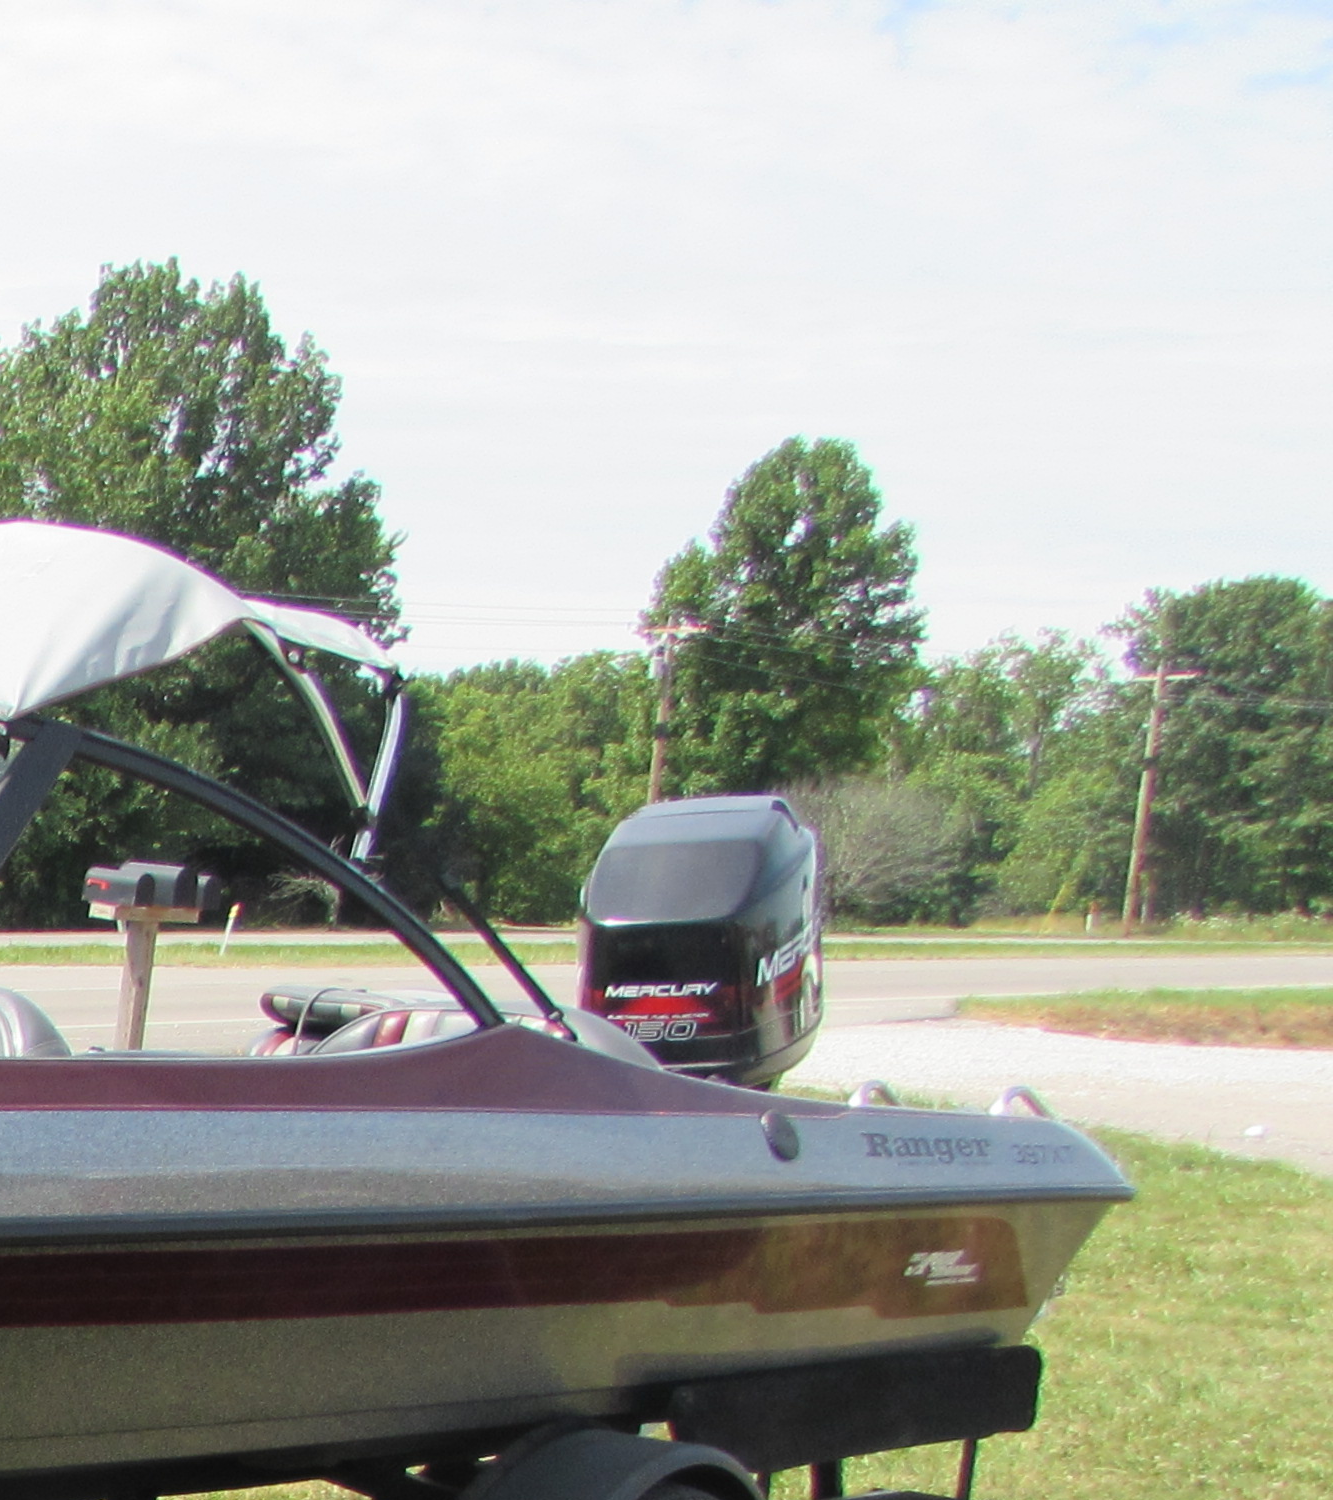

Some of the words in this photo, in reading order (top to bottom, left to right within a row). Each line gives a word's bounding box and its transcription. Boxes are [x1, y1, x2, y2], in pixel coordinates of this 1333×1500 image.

[605, 981, 718, 999] MERCURY
[623, 1020, 697, 1042] 150
[860, 1132, 991, 1165] Ranger
